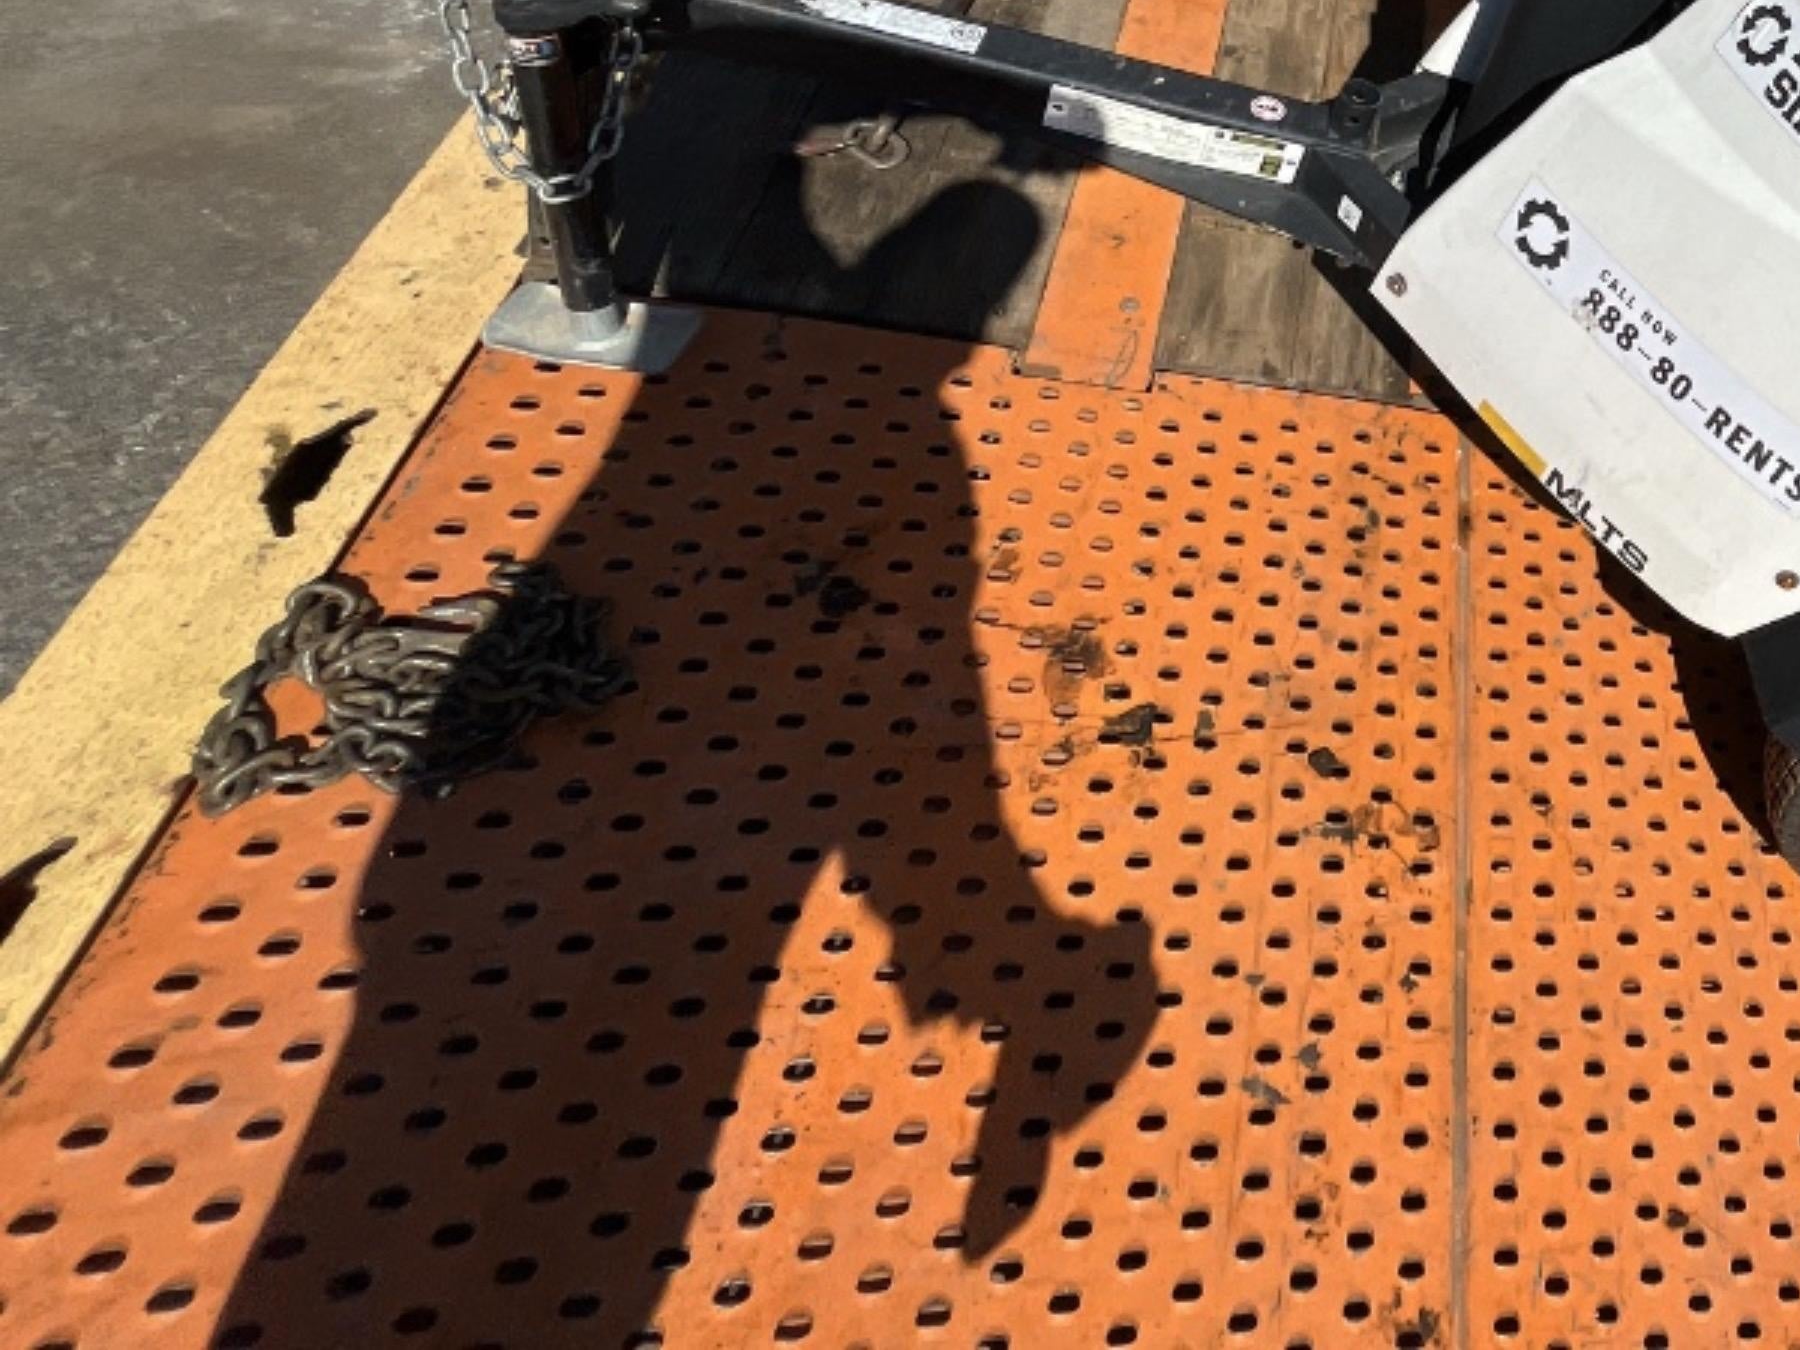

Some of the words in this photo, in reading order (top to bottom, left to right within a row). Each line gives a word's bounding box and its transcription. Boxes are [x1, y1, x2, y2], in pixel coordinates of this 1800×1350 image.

[1597, 269, 1638, 311] CALL
[1641, 311, 1677, 347] NOW
[1543, 466, 1649, 573] MLTS
